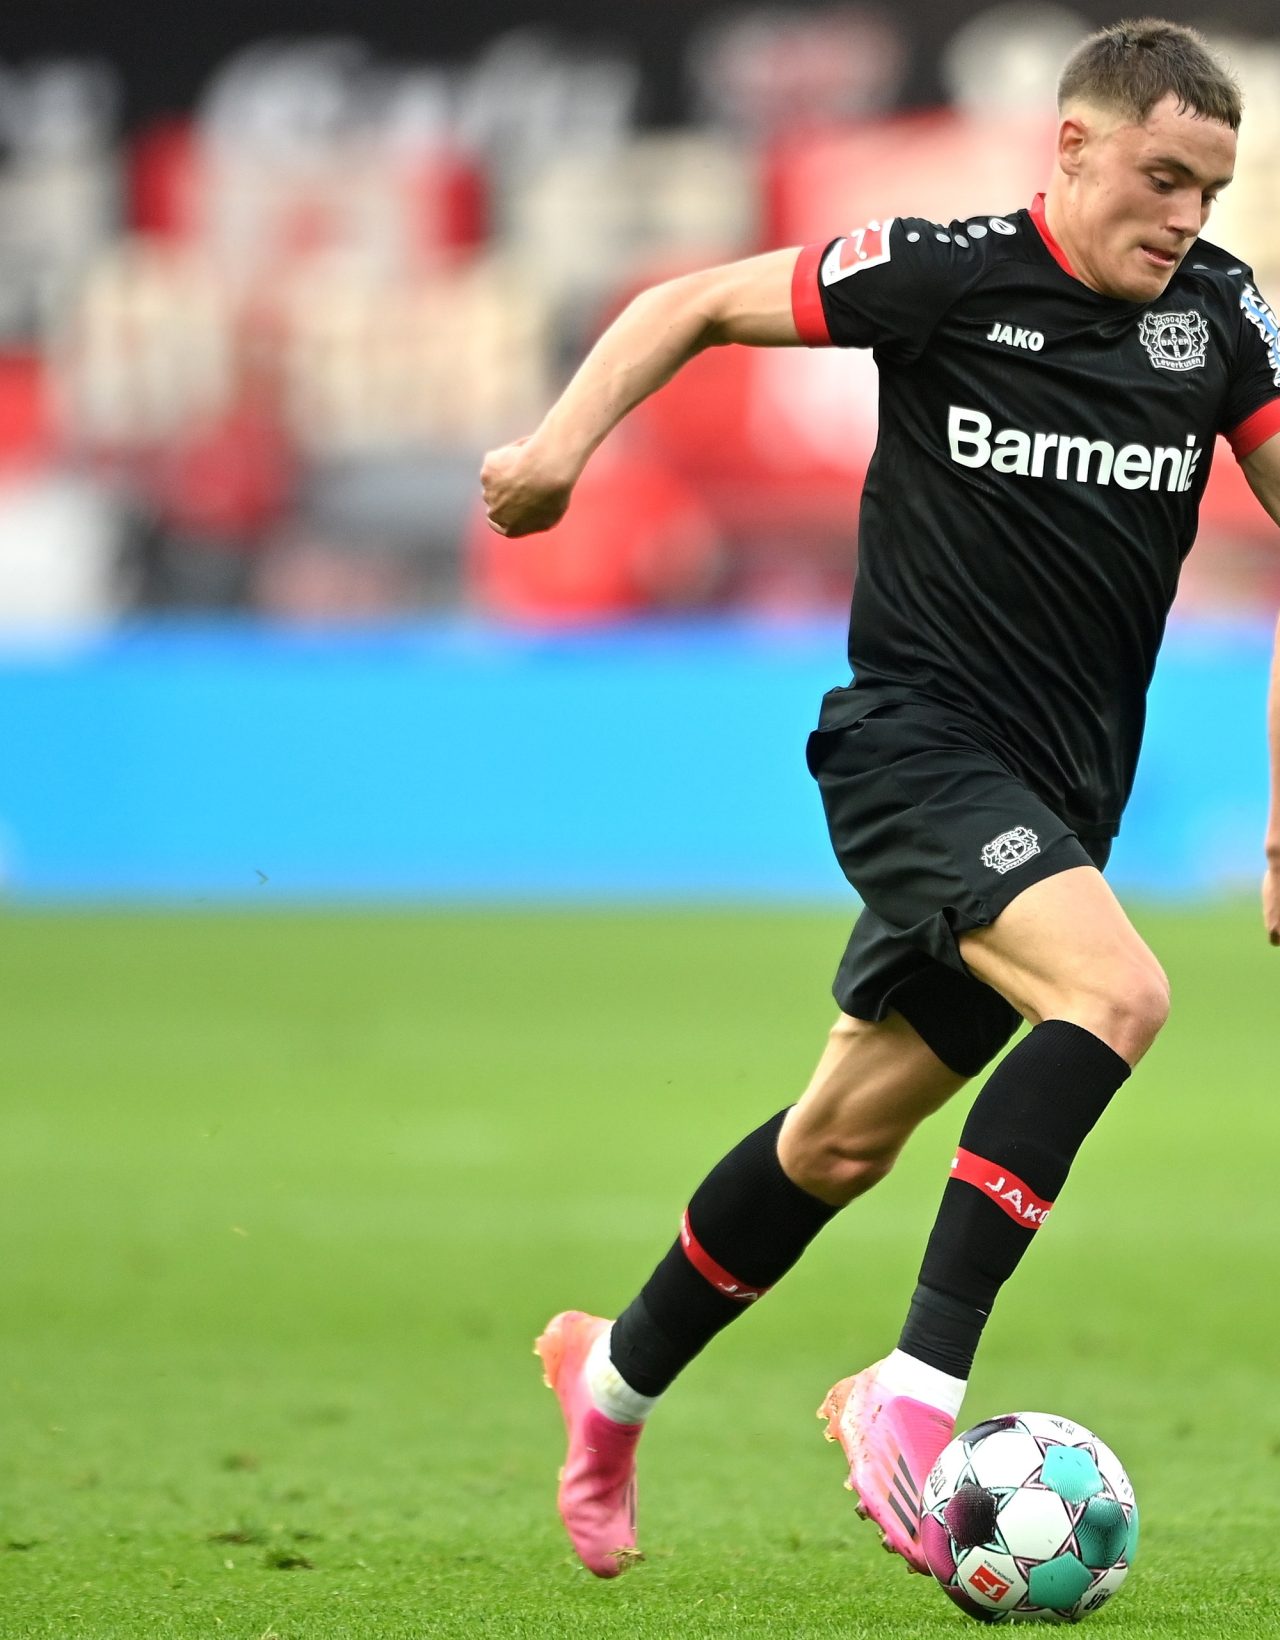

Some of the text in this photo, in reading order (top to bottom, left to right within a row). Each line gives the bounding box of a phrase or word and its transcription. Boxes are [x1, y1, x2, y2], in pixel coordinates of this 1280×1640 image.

[1162, 316, 1181, 325] 1904
[986, 322, 1045, 352] JAKO
[1160, 338, 1190, 347] BAYER
[1155, 357, 1202, 369] Leverkusen
